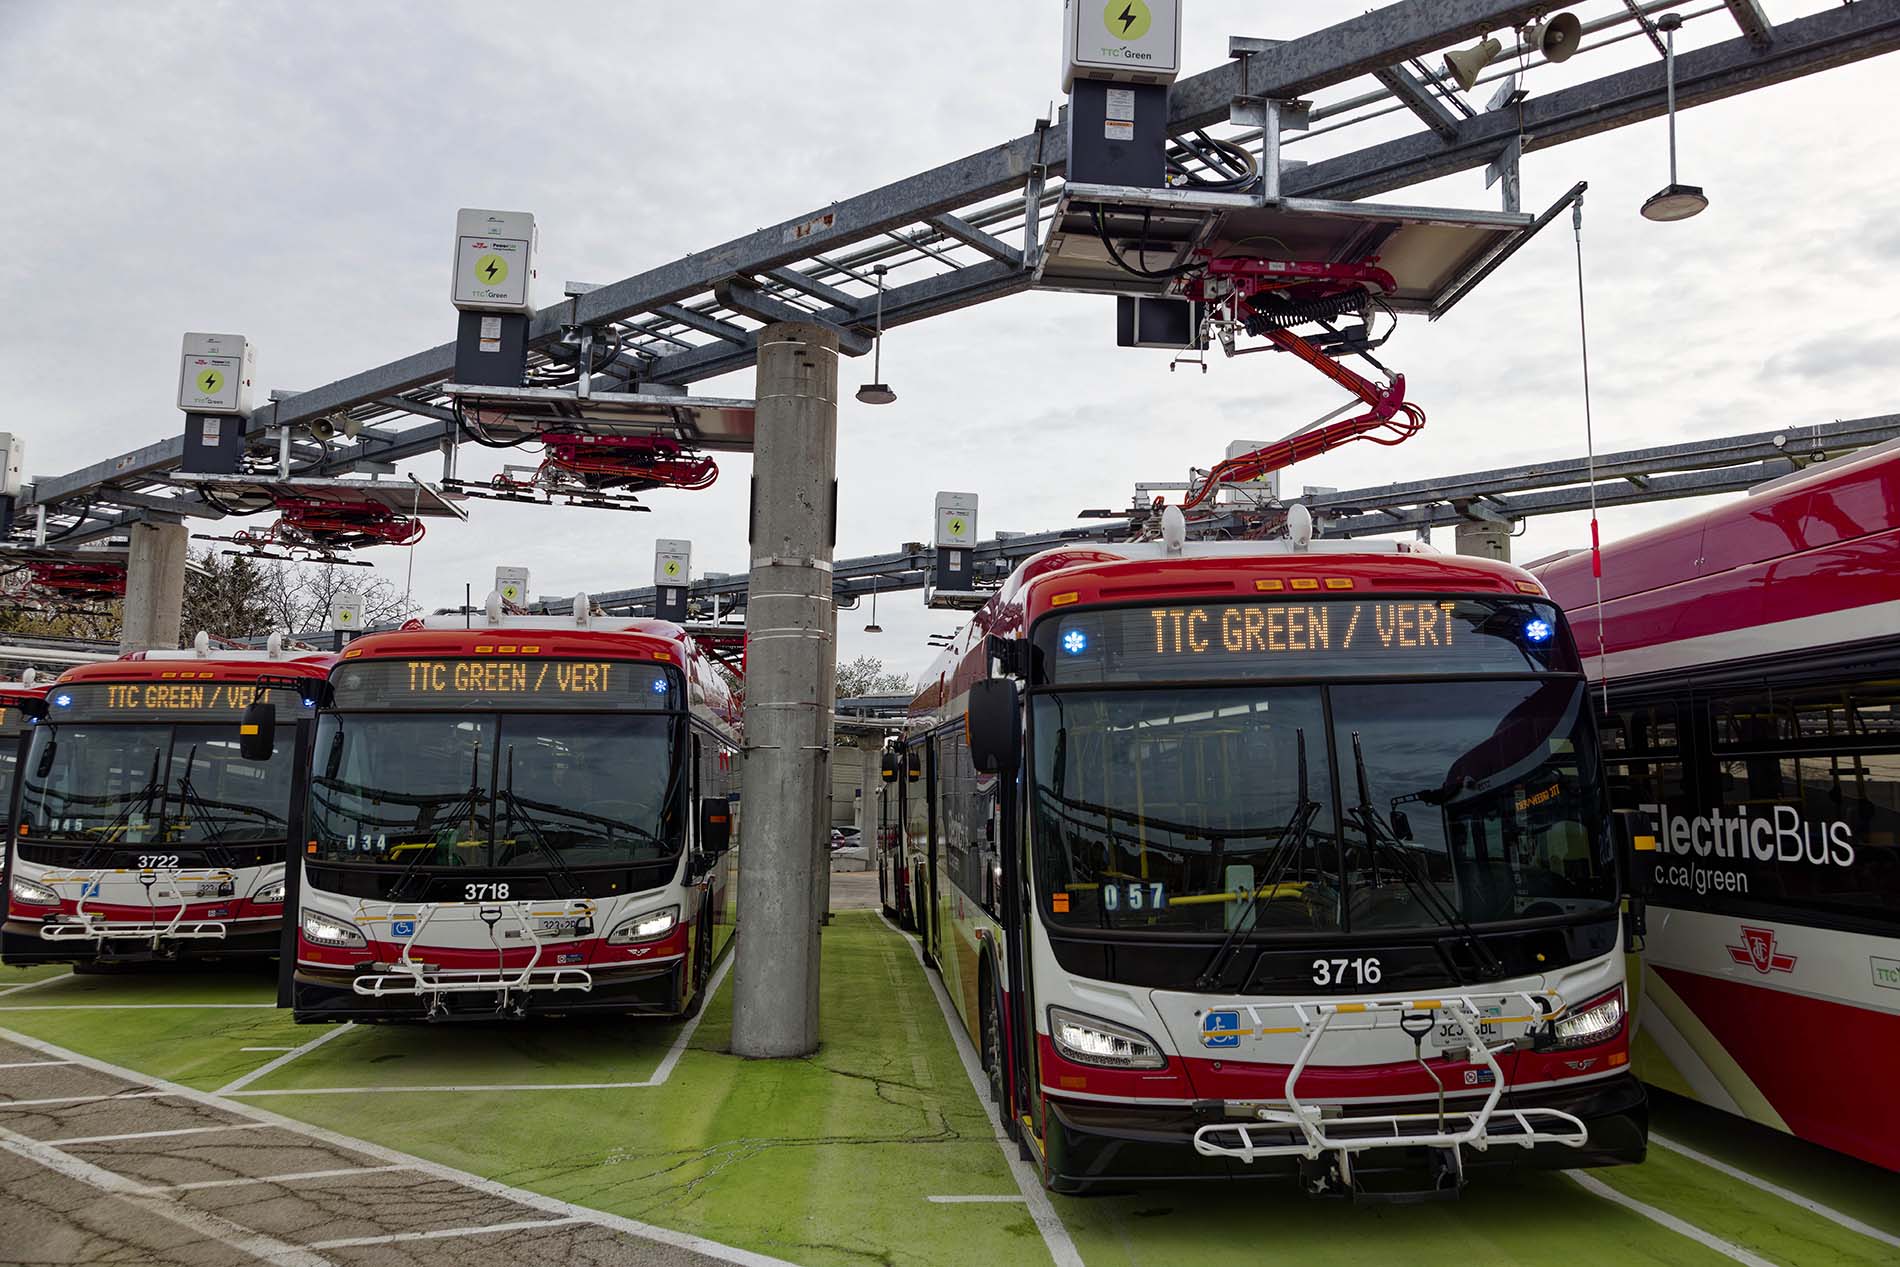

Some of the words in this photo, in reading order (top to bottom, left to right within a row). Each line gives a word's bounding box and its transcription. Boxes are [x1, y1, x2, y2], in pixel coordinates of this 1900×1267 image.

[1101, 47, 1120, 58] TTC
[1124, 48, 1152, 61] Green
[488, 291, 508, 299] Green
[1151, 609, 1209, 653] TTC
[1222, 608, 1328, 652] GREEN
[1343, 608, 1361, 647] /
[1375, 603, 1455, 646] VERT
[409, 662, 447, 692] TTC
[455, 662, 527, 692] GREEN
[535, 663, 549, 690] /
[556, 662, 611, 692] VERT
[107, 685, 140, 708] TTC
[145, 685, 204, 709] GREEN
[208, 686, 222, 709] /
[138, 855, 179, 869] 3722
[464, 883, 510, 900] 3718
[1312, 957, 1382, 986] 3716
[1876, 966, 1898, 983] TTC
